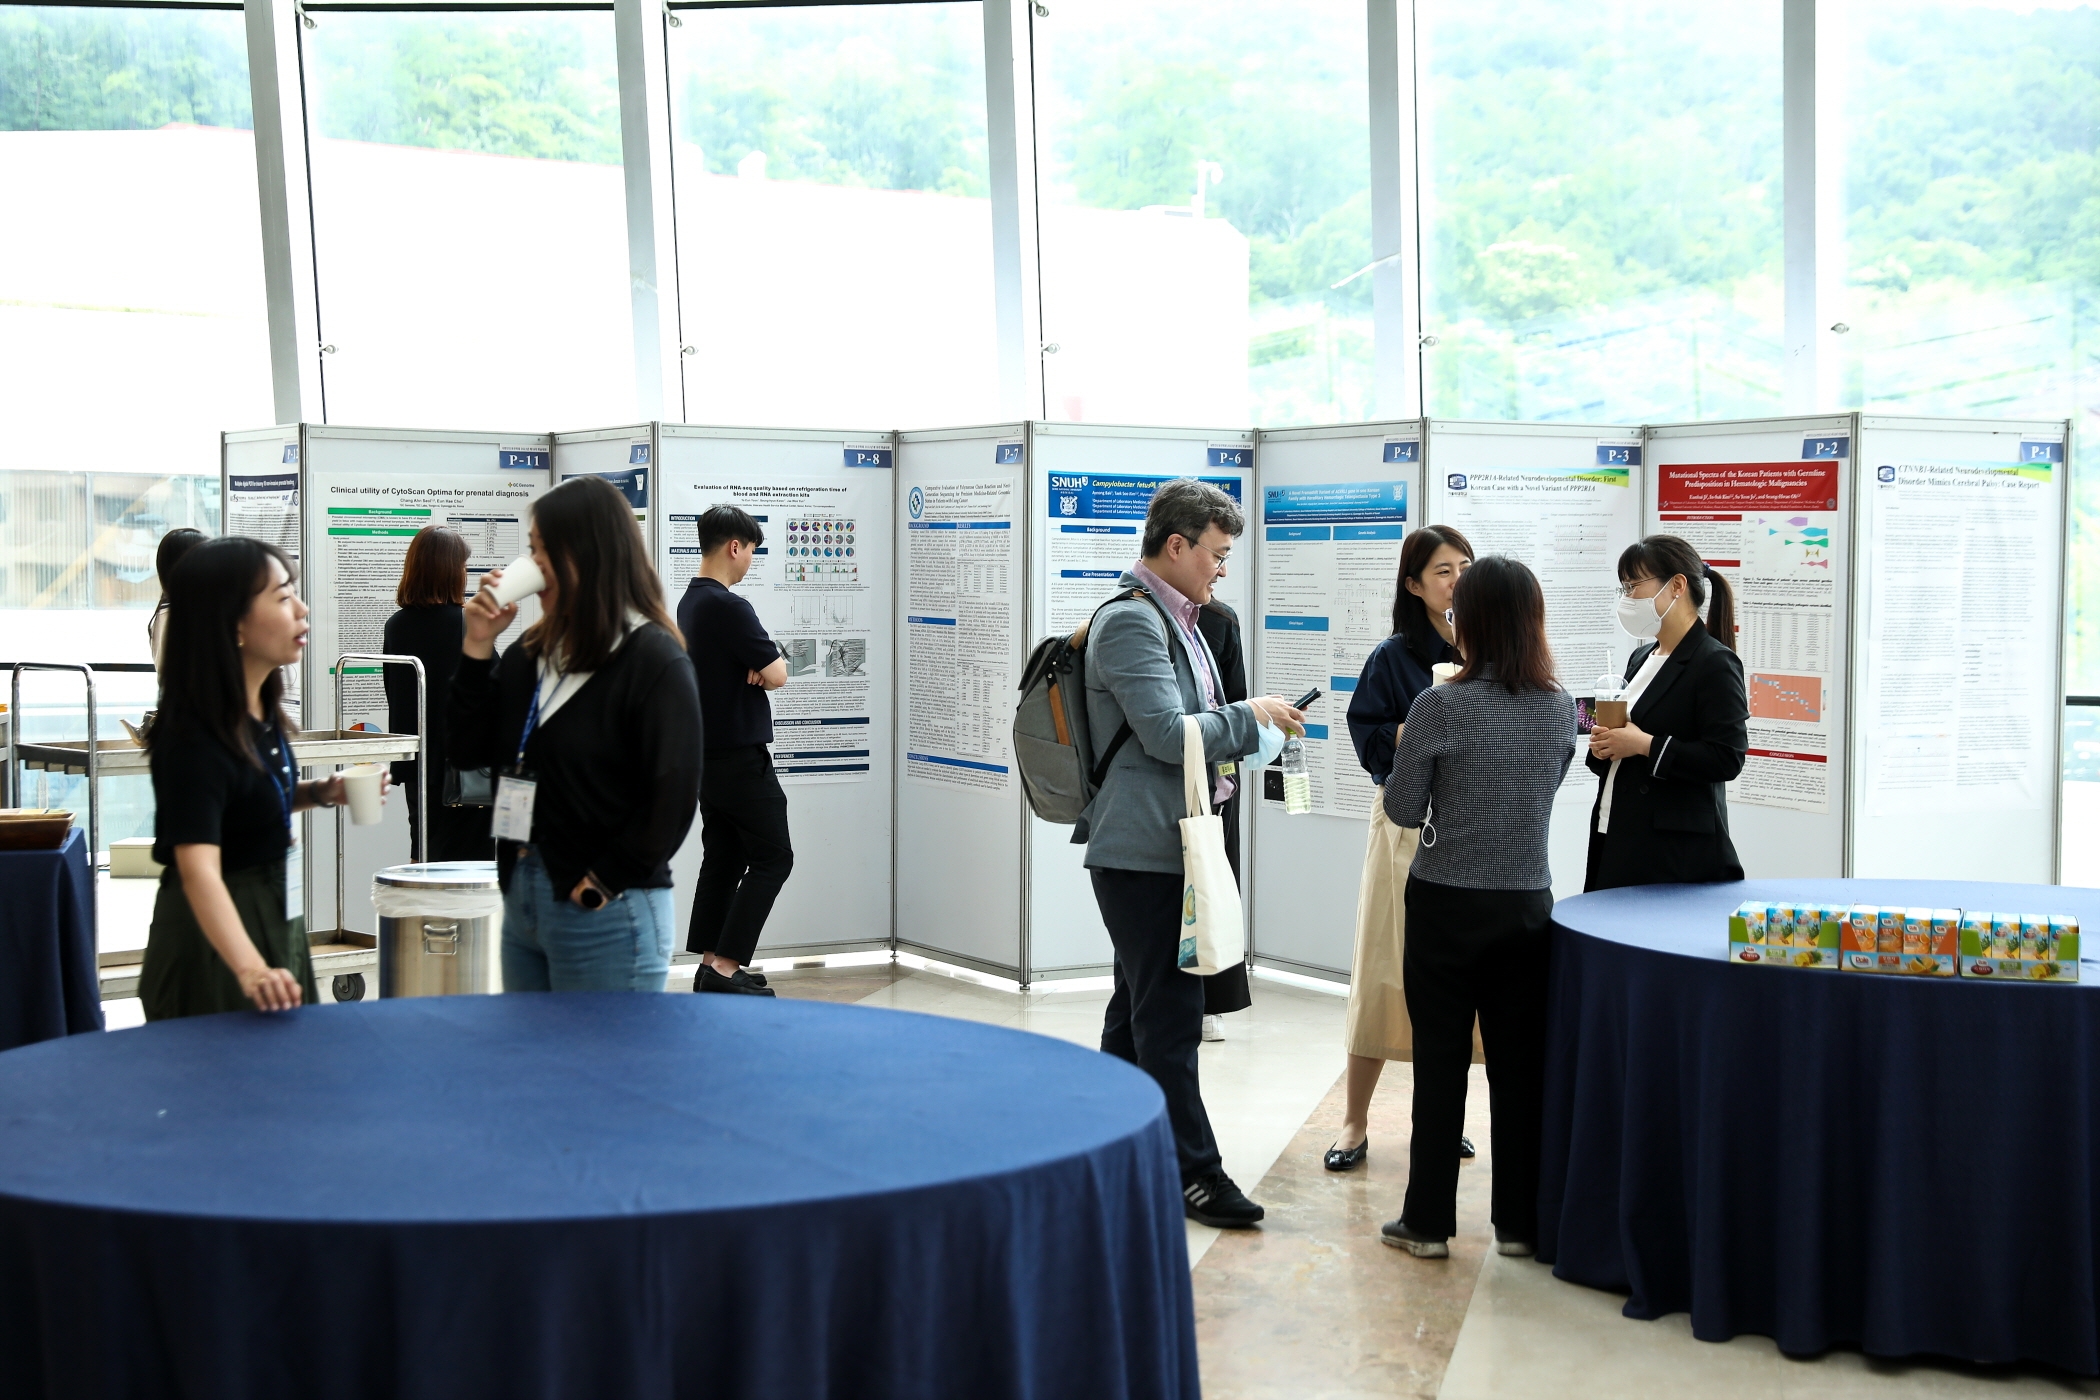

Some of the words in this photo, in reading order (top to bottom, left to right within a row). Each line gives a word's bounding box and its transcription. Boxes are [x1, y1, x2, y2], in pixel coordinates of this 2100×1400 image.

[637, 448, 648, 460] P-9
[1004, 448, 1019, 460] P-7
[1394, 446, 1412, 459] P-4
[1815, 442, 1838, 455] P-2
[2031, 446, 2051, 459] P-1
[509, 455, 540, 467] P-11
[857, 453, 880, 465] P-8
[1220, 452, 1241, 465] P-6
[1608, 450, 1630, 462] P-3
[1699, 471, 1719, 480] Spectra
[1797, 469, 1826, 477] Germline
[1956, 467, 2019, 477] Neurodevelopmental
[1052, 477, 1082, 488] SNUH
[1092, 480, 1135, 488] Campylobacter
[1521, 475, 1576, 483] Neurodevelopmental
[1685, 481, 1723, 489] Predisposition
[1731, 480, 1767, 488] Hematologic
[1768, 479, 1808, 488] Malignancies
[1898, 477, 1926, 485] Disorder
[1928, 478, 1951, 486] Mimics
[1952, 479, 1980, 487] Cerebral
[2002, 480, 2016, 488] Case
[2018, 481, 2040, 490] Report
[360, 487, 380, 496] utility
[391, 488, 425, 497] CytoScan
[427, 489, 453, 497] Optima
[466, 490, 494, 498] prenatal
[496, 490, 529, 498] diagnosis
